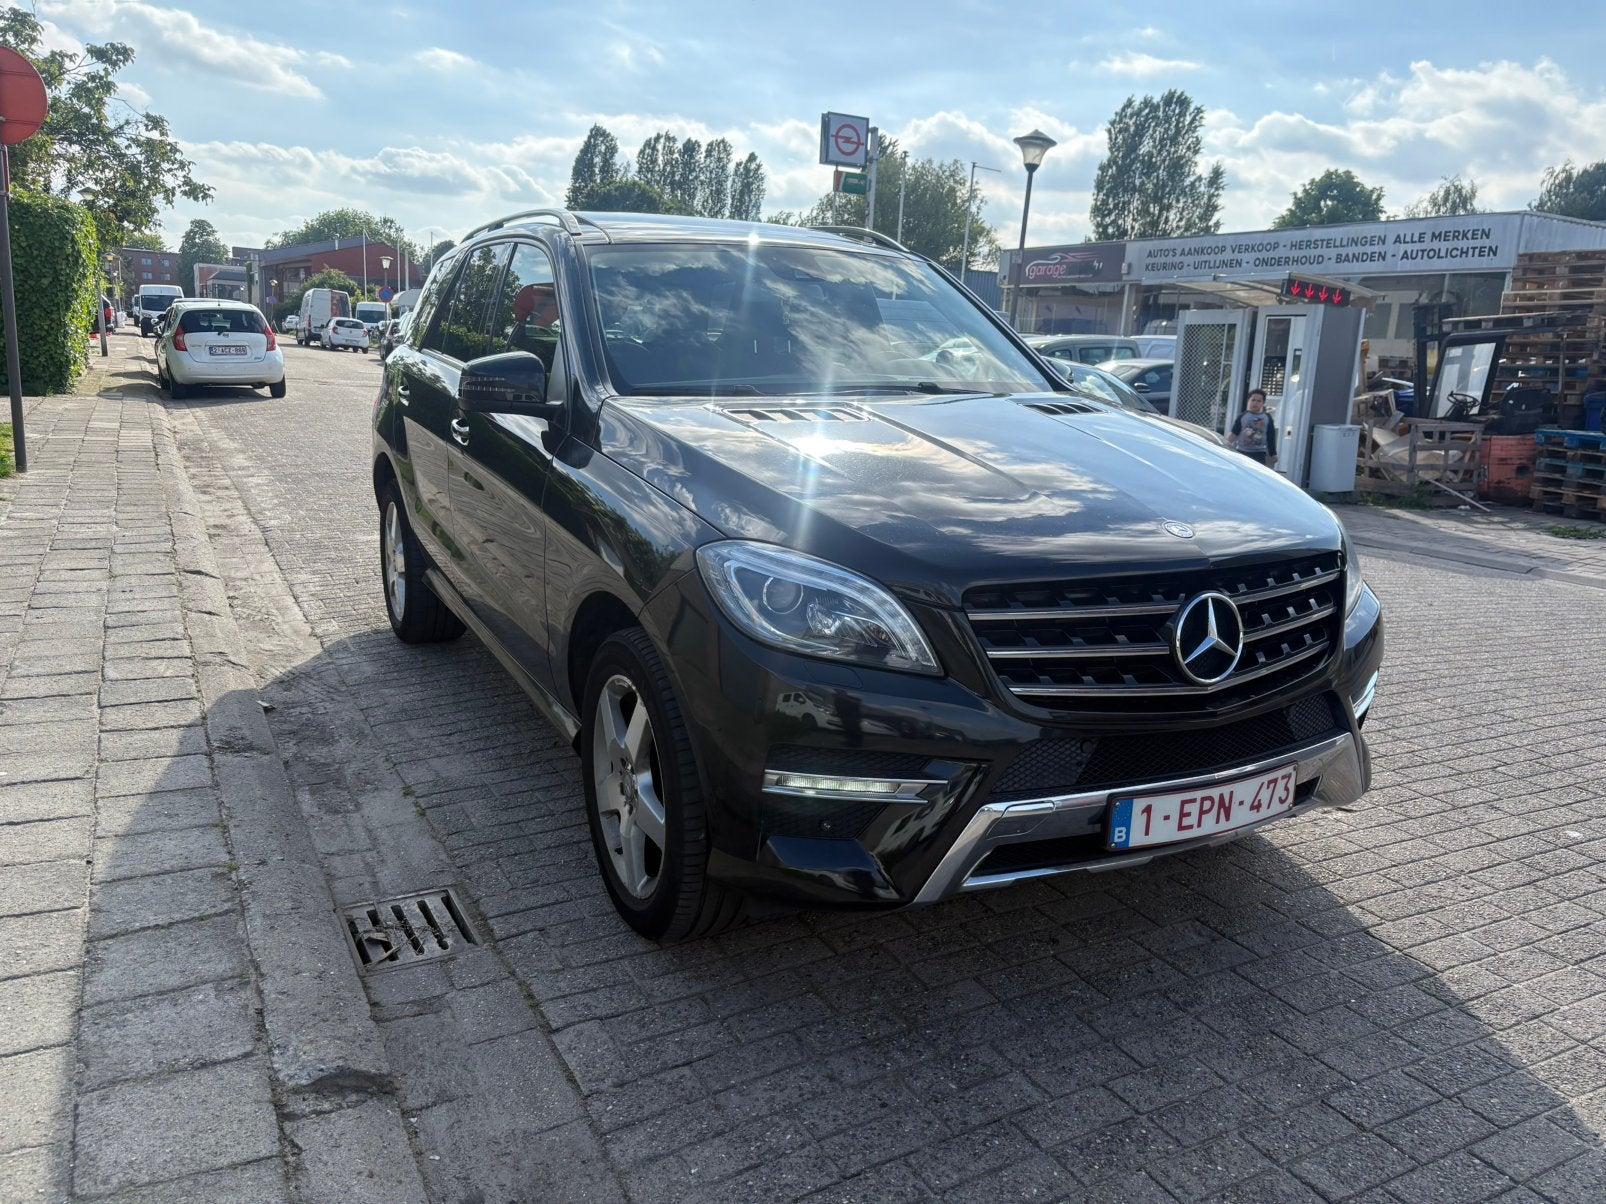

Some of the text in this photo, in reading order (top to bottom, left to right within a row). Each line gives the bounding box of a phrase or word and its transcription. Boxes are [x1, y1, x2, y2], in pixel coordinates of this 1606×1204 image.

[1146, 247, 1177, 259] AUTO'S
[1179, 244, 1227, 257] AANKOOP
[1230, 241, 1280, 254] VERKOOP
[1289, 234, 1387, 251] HERSTELLINGEN
[1393, 232, 1427, 245] ALLE
[1430, 228, 1492, 243] MERKEN
[1029, 264, 1067, 279] garage
[1145, 260, 1185, 272] KEURING
[1193, 258, 1243, 270] UITLIJNEN
[1253, 254, 1325, 268] ONDERHOUD
[1335, 250, 1387, 264] BANDEN
[1400, 245, 1499, 261] AUTOLICHTEN
[1113, 772, 1293, 843] B 1-EPN-473
